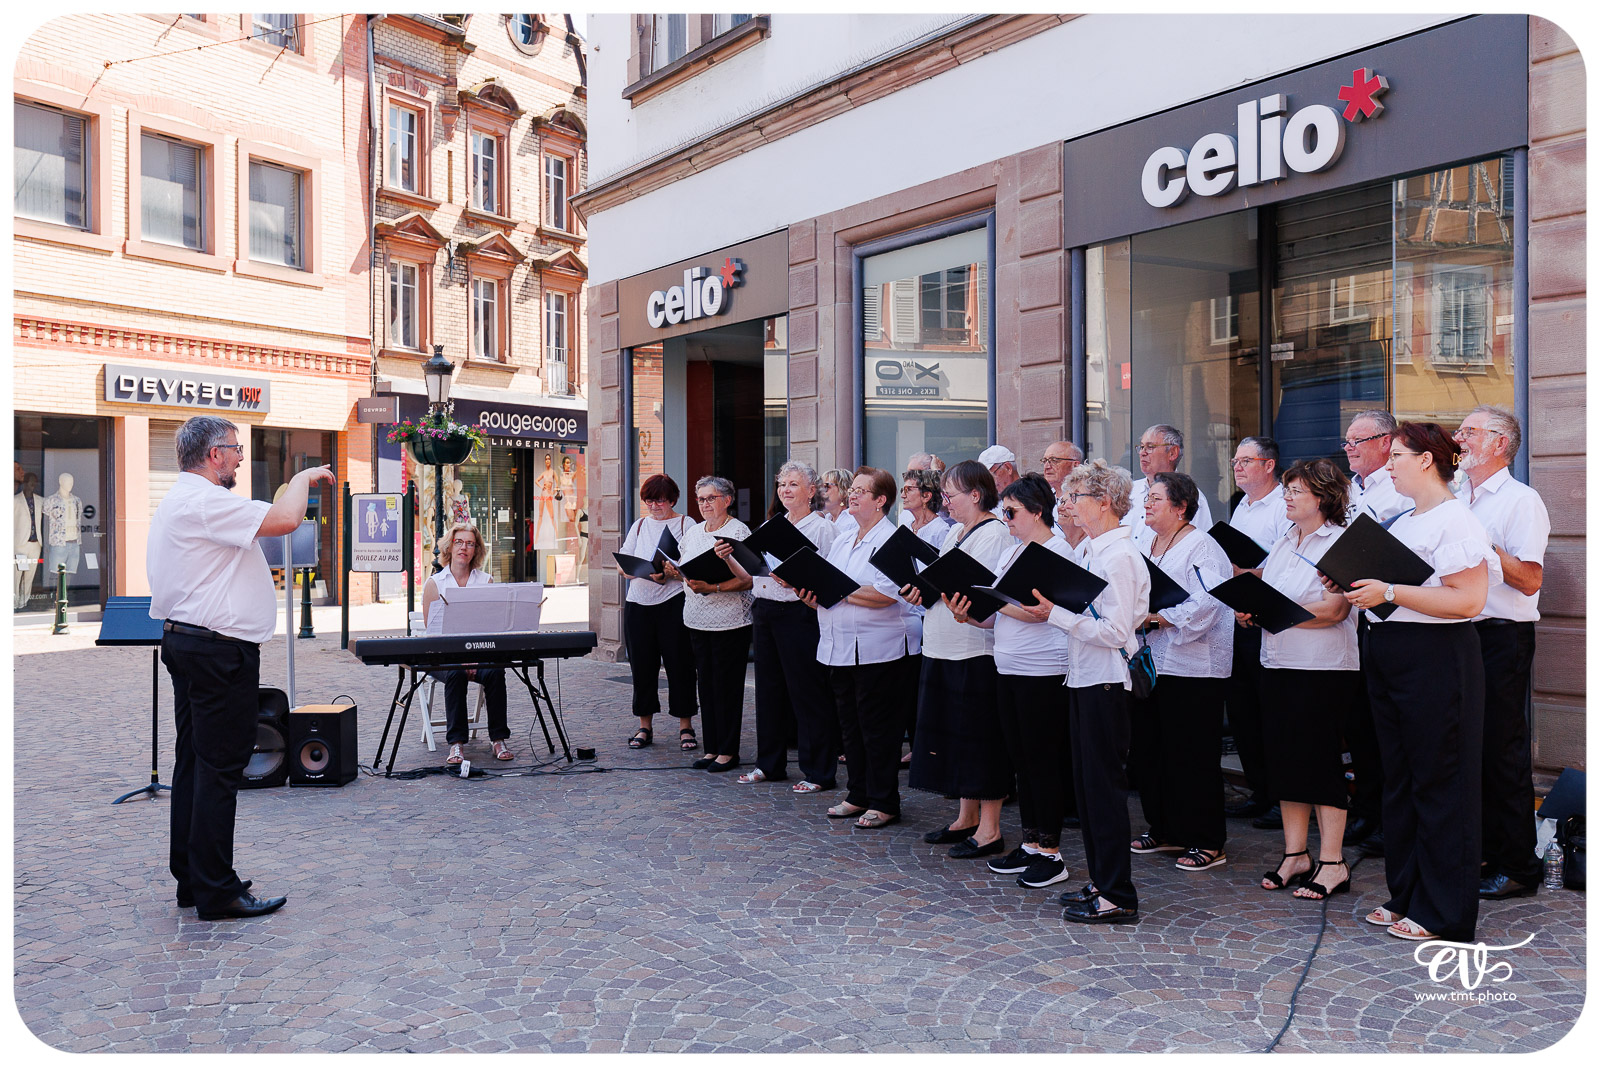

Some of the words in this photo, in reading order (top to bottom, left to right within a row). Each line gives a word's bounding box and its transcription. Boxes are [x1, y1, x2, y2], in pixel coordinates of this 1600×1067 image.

[241, 386, 262, 403] 1902
[491, 438, 554, 449] LINGERIE
[355, 554, 378, 562] ROULEZ
[379, 554, 387, 562] AU
[388, 554, 400, 562] PAS
[472, 641, 496, 649] YAMAHA
